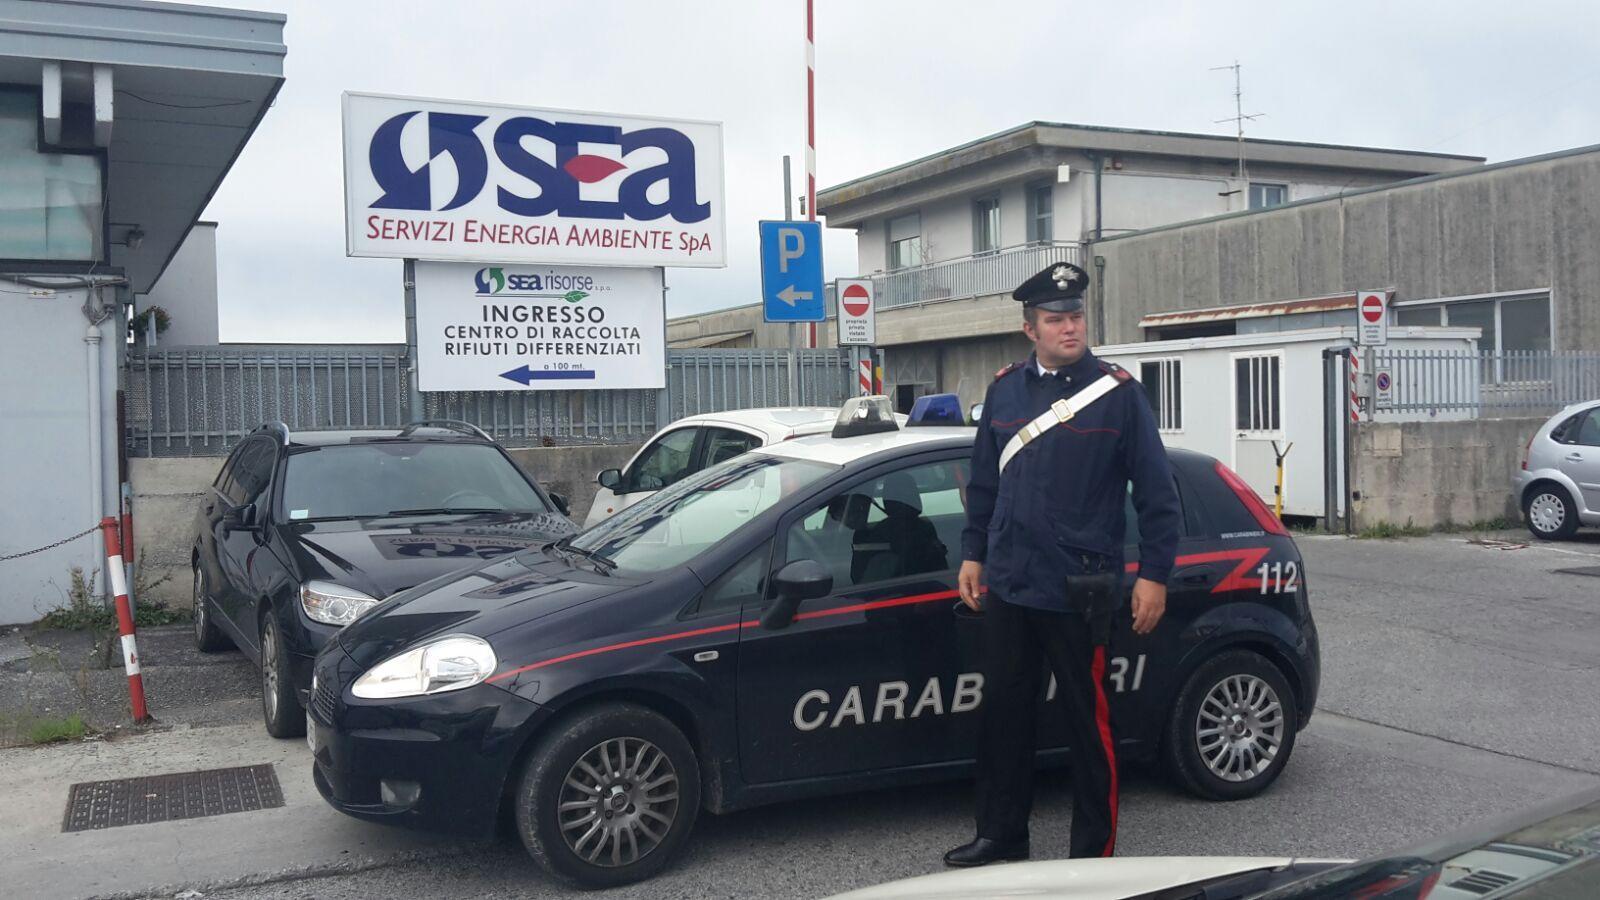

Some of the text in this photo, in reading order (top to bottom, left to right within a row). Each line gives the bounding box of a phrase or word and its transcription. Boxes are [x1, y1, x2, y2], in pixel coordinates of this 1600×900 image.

[367, 215, 712, 256] SERVIZI ENERGIA AMBIENTE SpA
[778, 227, 805, 273] P
[545, 270, 593, 291] risorse
[483, 304, 605, 323] INGRESSO
[444, 325, 641, 340] CENTRO DI RACCOLTA
[445, 342, 641, 356] RIFIUTI DIFFERENZIATI
[553, 362, 569, 370] 100
[1257, 561, 1297, 595] 112
